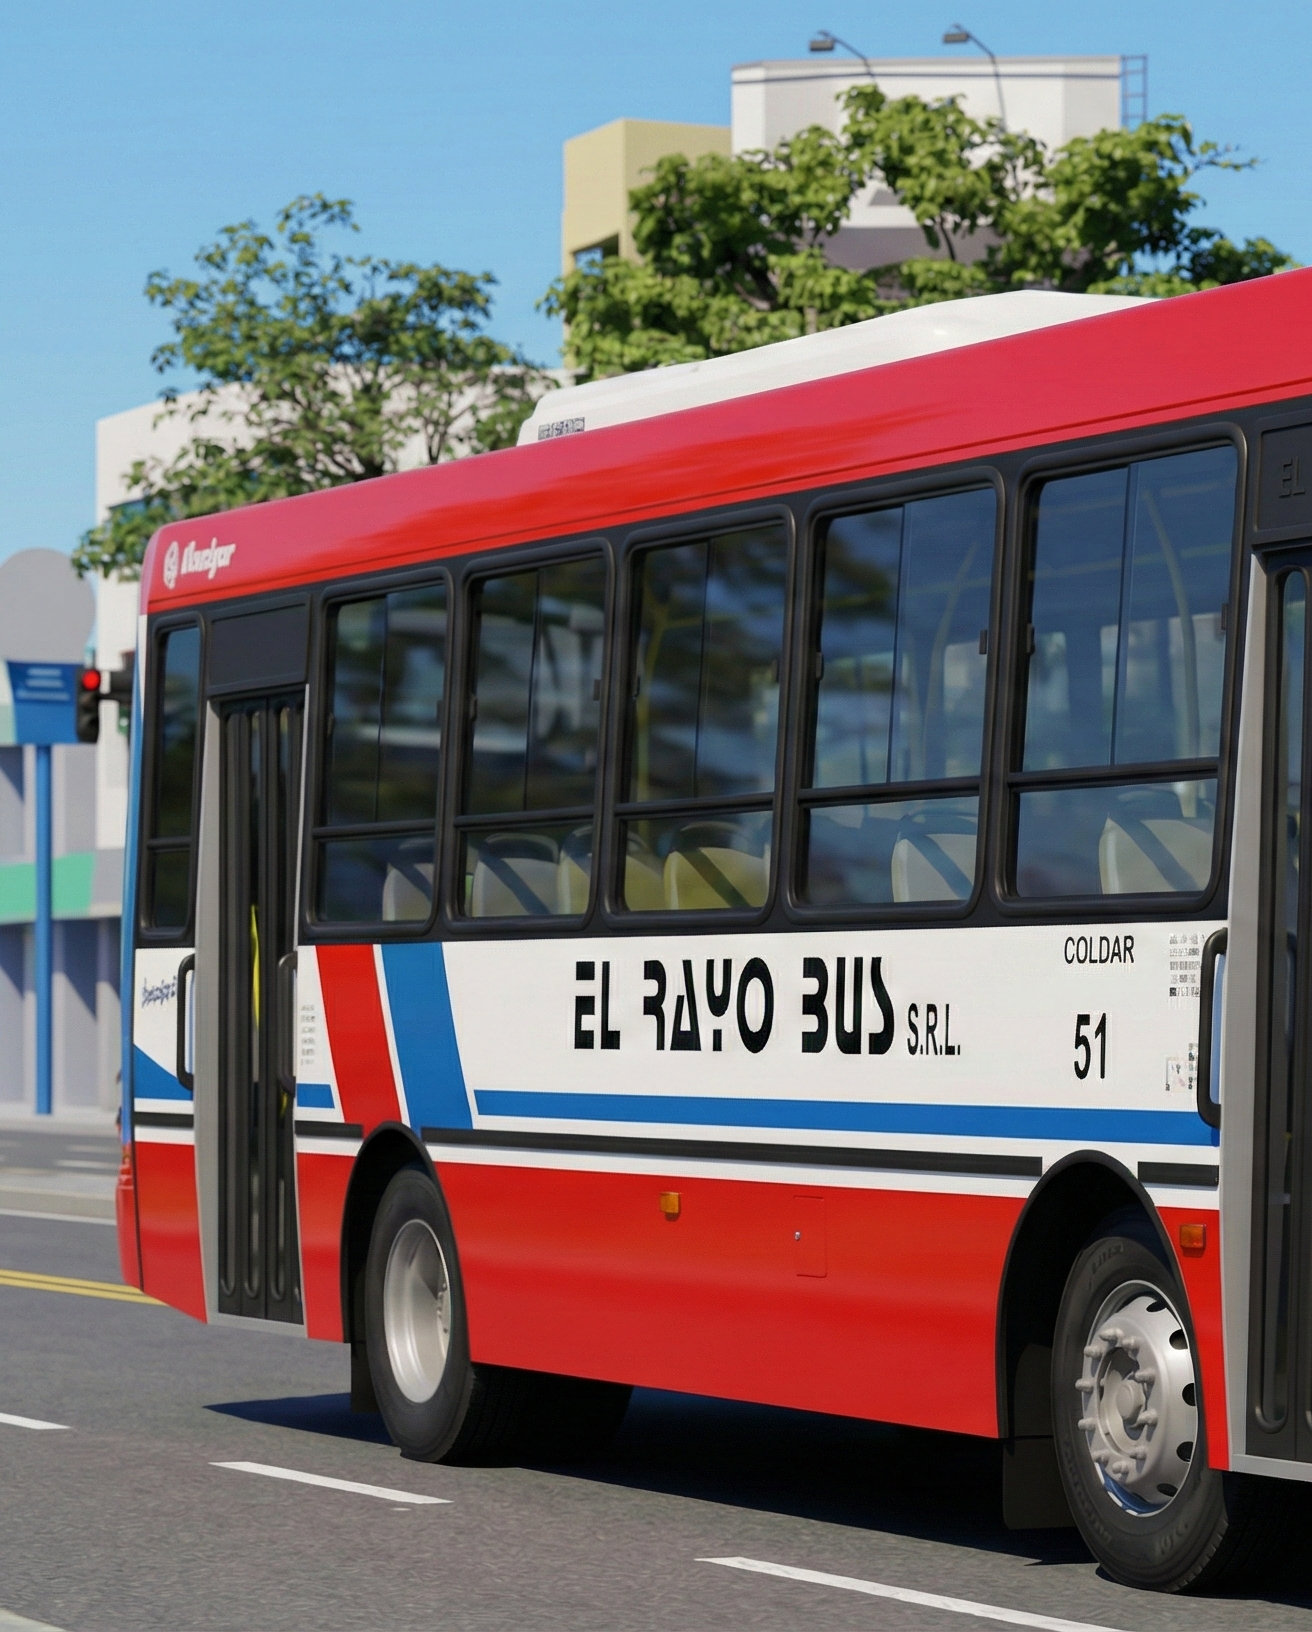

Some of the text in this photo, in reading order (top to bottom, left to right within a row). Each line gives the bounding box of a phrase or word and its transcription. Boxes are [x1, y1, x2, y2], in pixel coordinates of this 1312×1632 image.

[1278, 456, 1306, 499] EL
[1064, 935, 1135, 965] COLDAR
[574, 957, 961, 1056] EL RAYO BUS S.R.L.
[1074, 1012, 1107, 1080] 51
